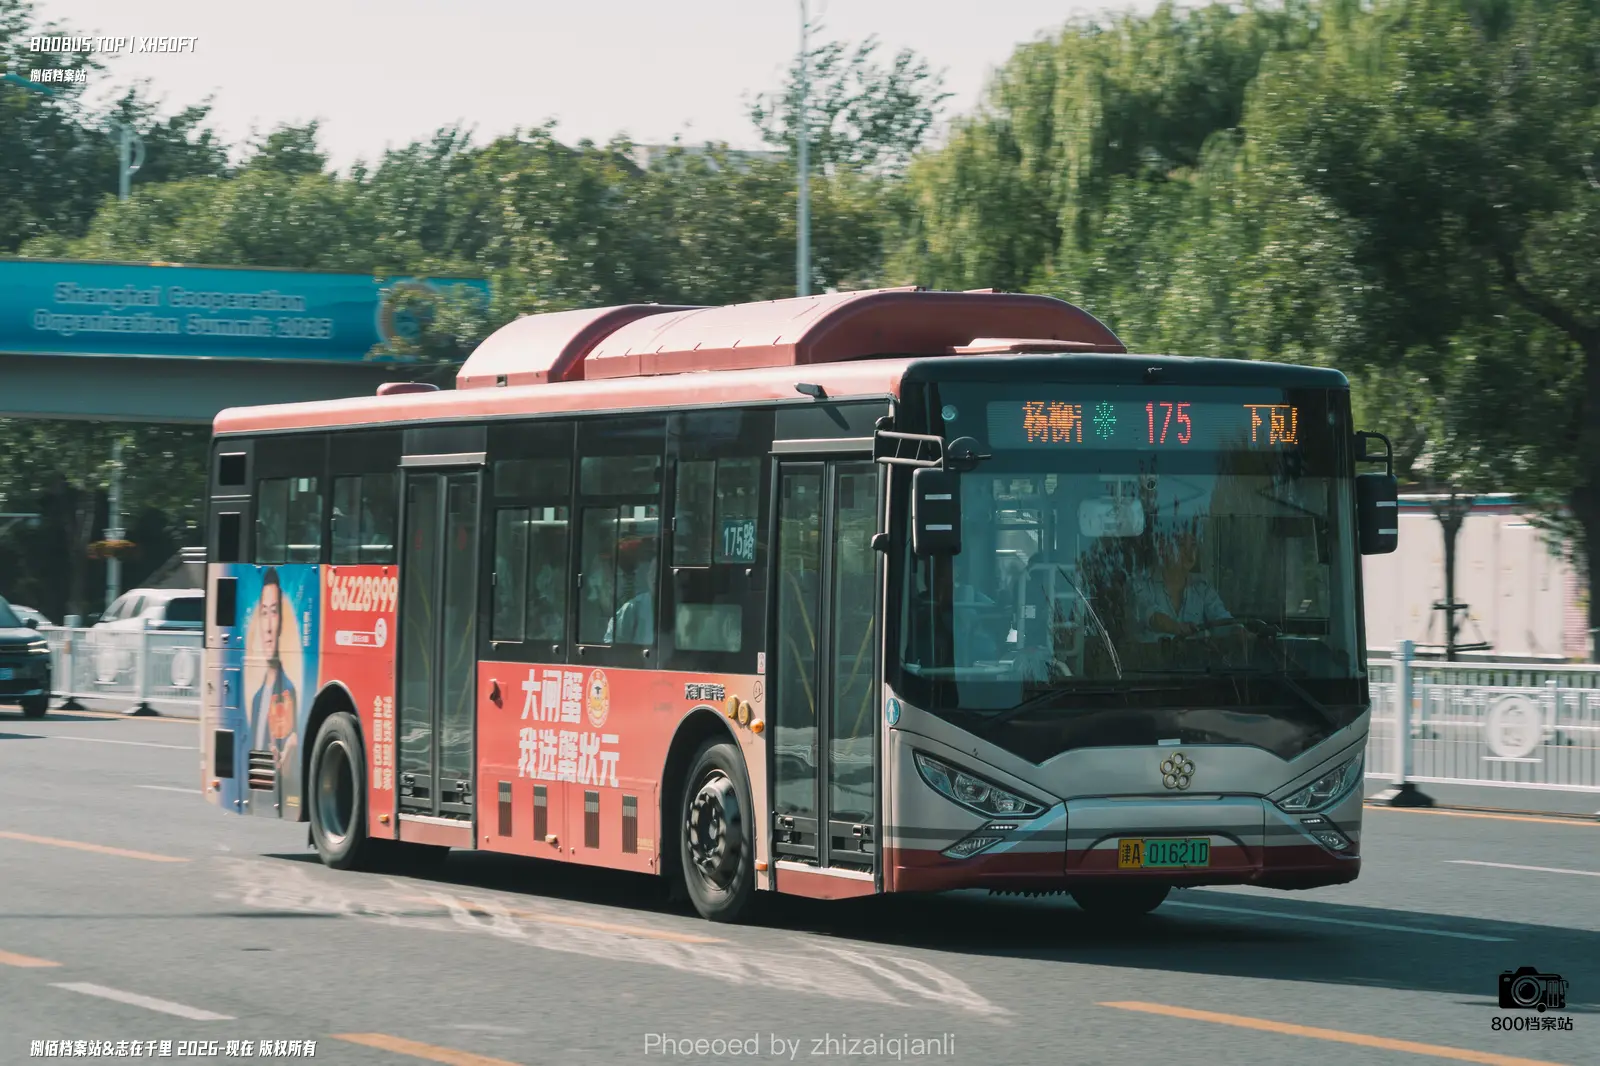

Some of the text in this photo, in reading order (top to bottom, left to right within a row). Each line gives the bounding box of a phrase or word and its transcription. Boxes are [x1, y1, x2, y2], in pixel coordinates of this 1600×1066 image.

[55, 282, 305, 313] Shanghai Cooperation
[187, 313, 272, 337] Summit
[1022, 400, 1083, 443] 杨柳
[1145, 400, 1192, 444] 175
[1243, 404, 1299, 445] 下瓦
[723, 522, 755, 559] 175路
[331, 575, 398, 613] 66228999
[521, 669, 583, 724] 大闸蟹
[518, 727, 620, 788] 我选蟹状元
[1121, 843, 1208, 864] 津A 01621D
